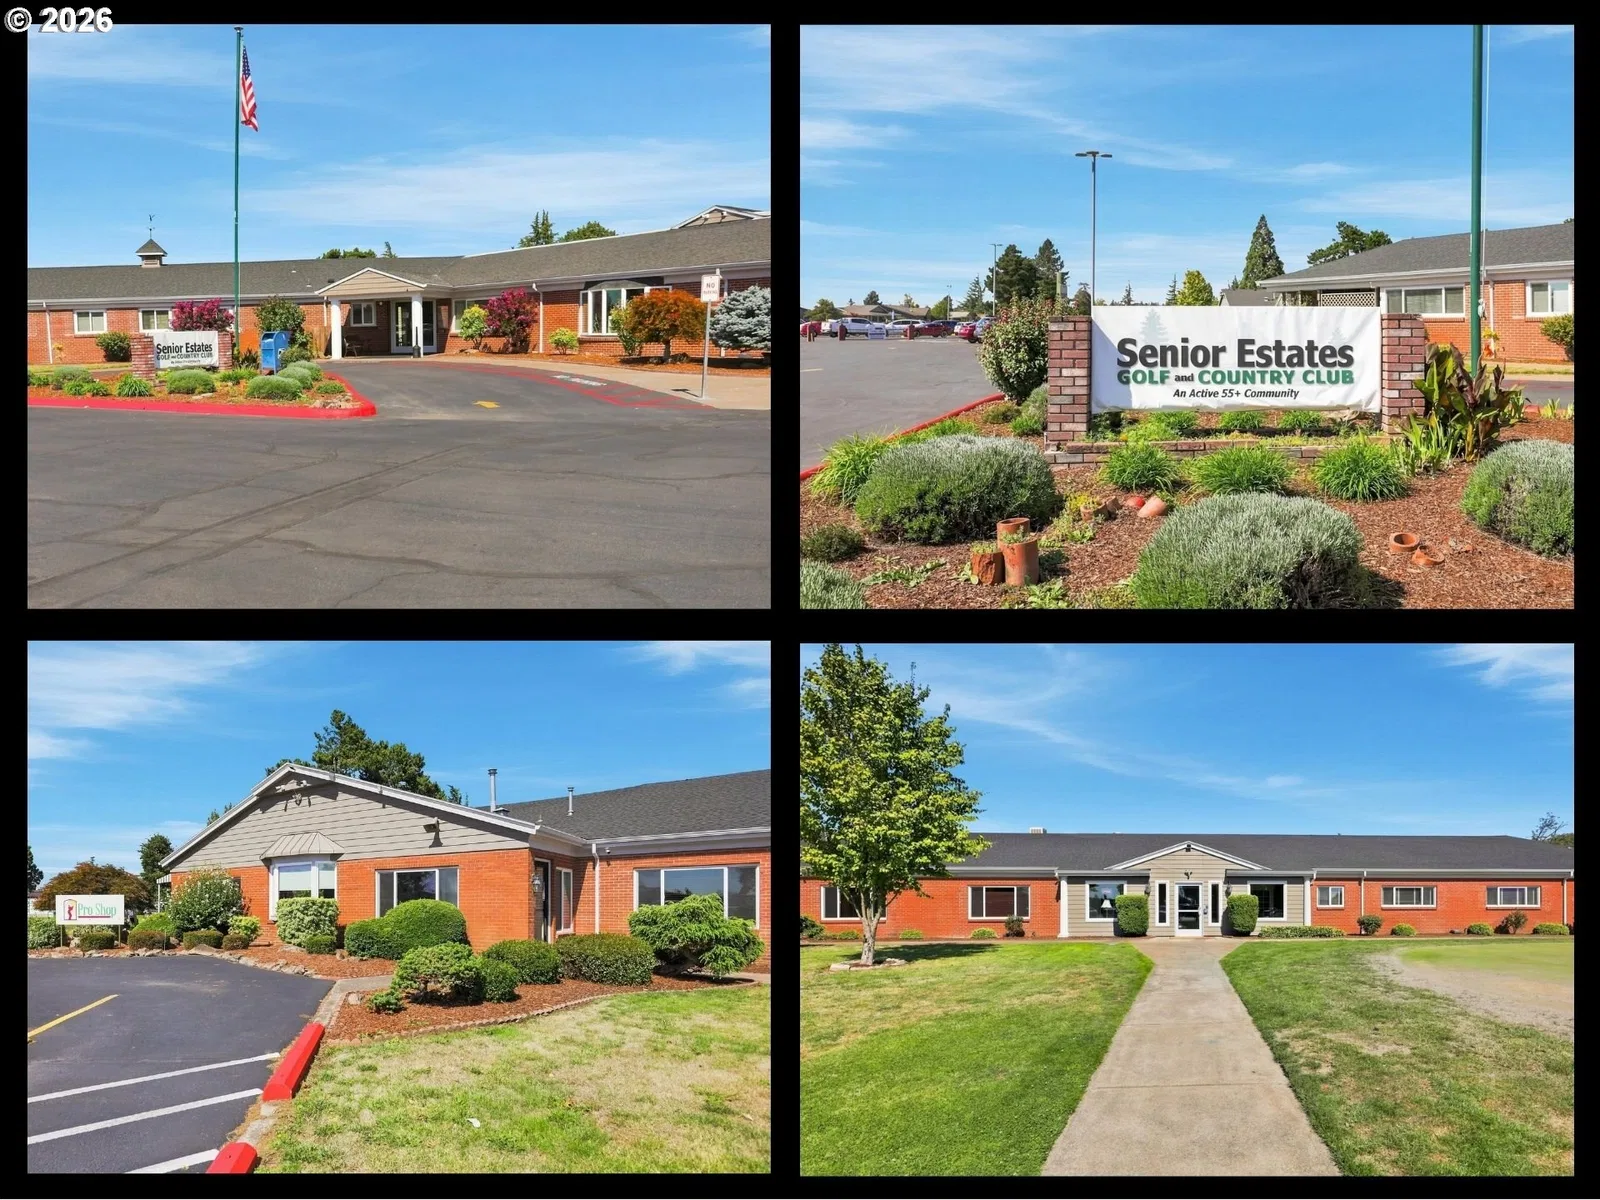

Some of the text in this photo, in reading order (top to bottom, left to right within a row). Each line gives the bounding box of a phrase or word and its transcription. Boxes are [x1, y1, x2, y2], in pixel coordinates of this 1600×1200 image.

[156, 342, 212, 354] Senior Estates
[1116, 337, 1355, 368] Senior Estates
[1116, 369, 1355, 385] GOLF and COUNTRY CLUB
[1173, 388, 1300, 400] An Active 55+ Community
[77, 902, 117, 917] Pro Shop
